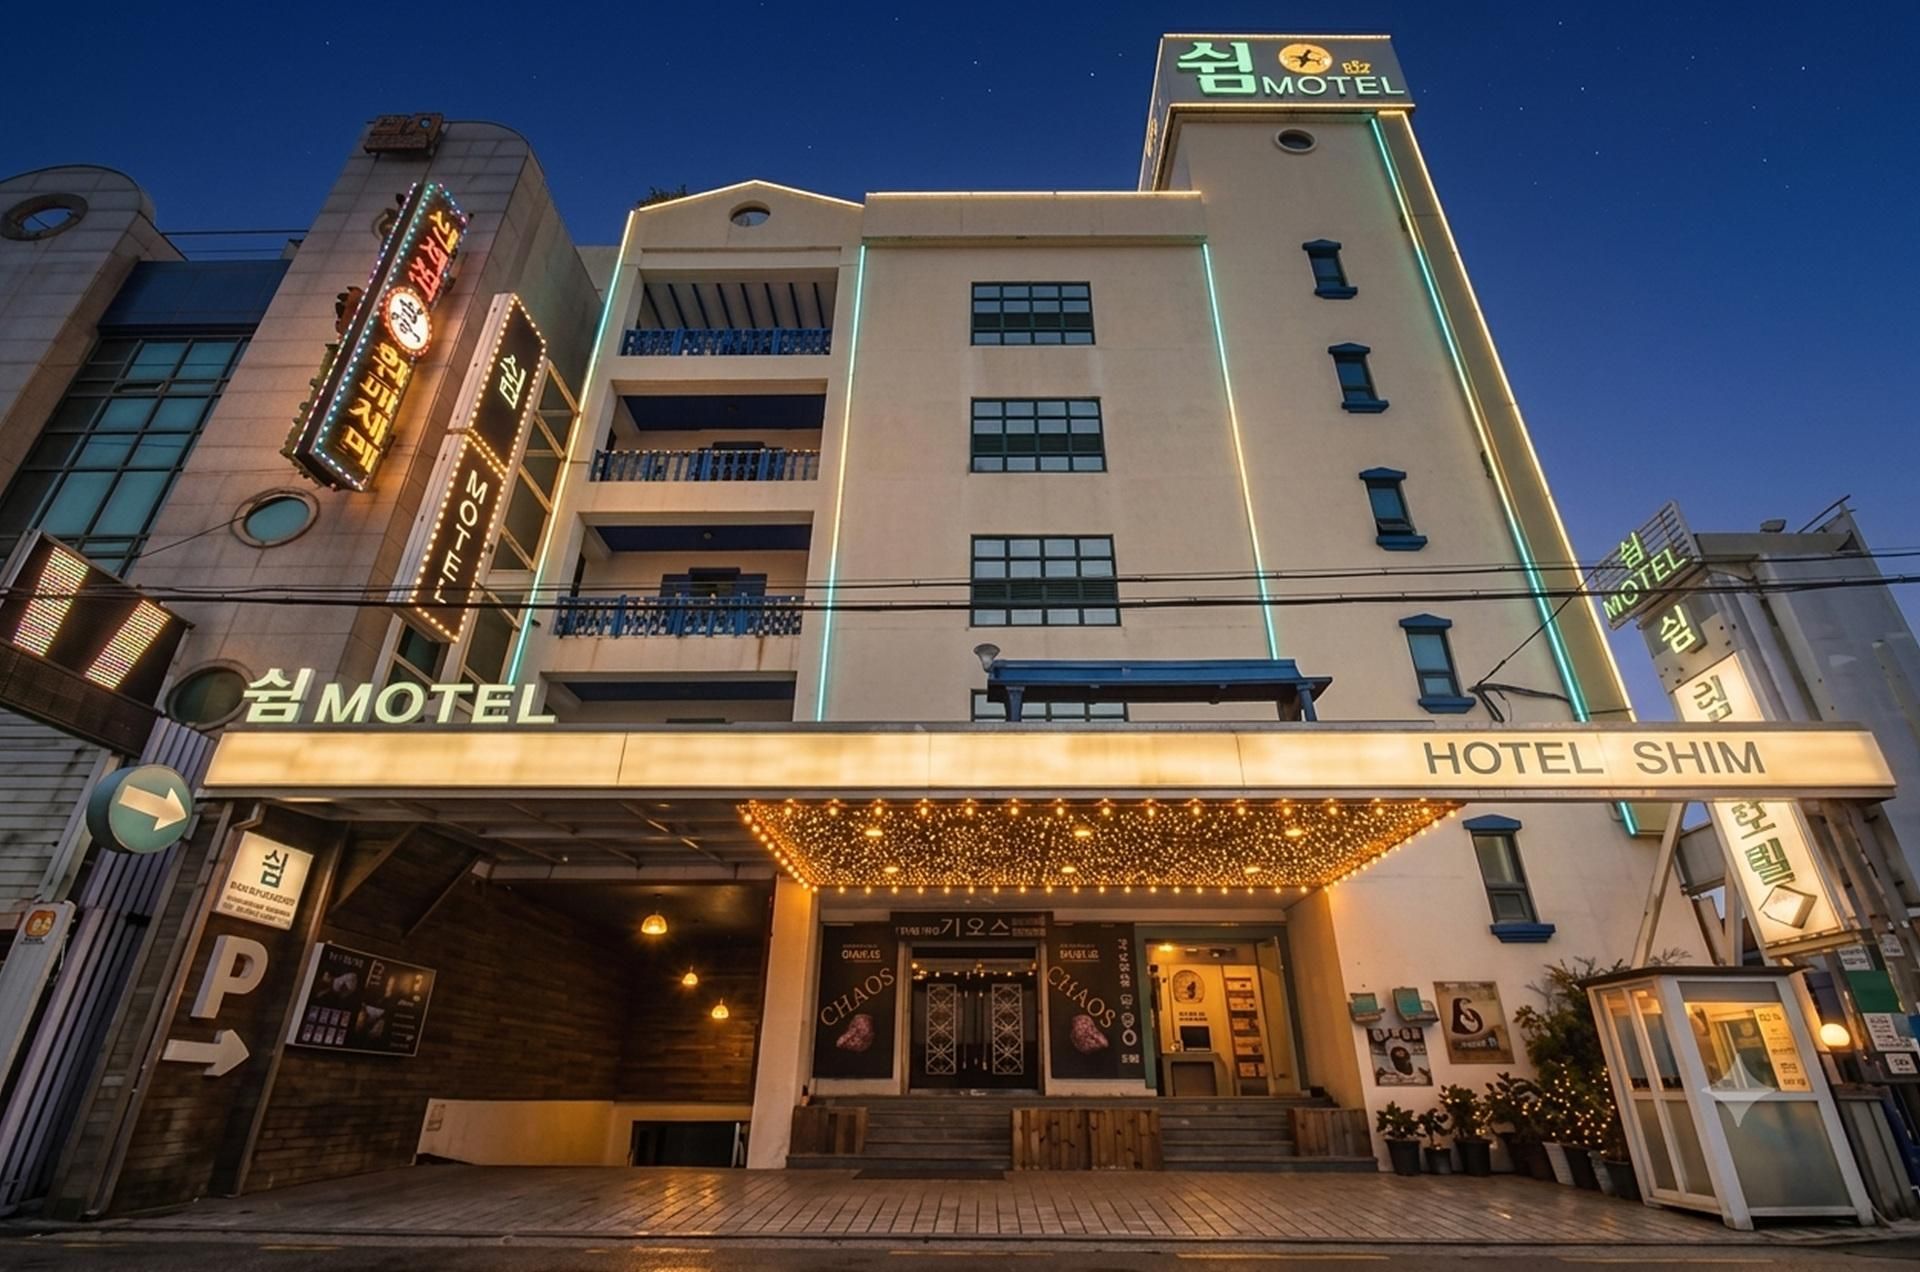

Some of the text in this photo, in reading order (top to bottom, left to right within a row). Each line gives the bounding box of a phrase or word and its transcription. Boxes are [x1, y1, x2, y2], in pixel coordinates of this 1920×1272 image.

[1177, 42, 1405, 95] 쉼 MOTEL
[434, 470, 489, 605] MOTEL
[1603, 548, 1688, 619] MOTEL
[243, 668, 558, 724] 쉼 MOTEL
[1423, 741, 1766, 775] HOTEL SHIM
[190, 935, 269, 1019] P
[820, 967, 895, 1026] CHAOS
